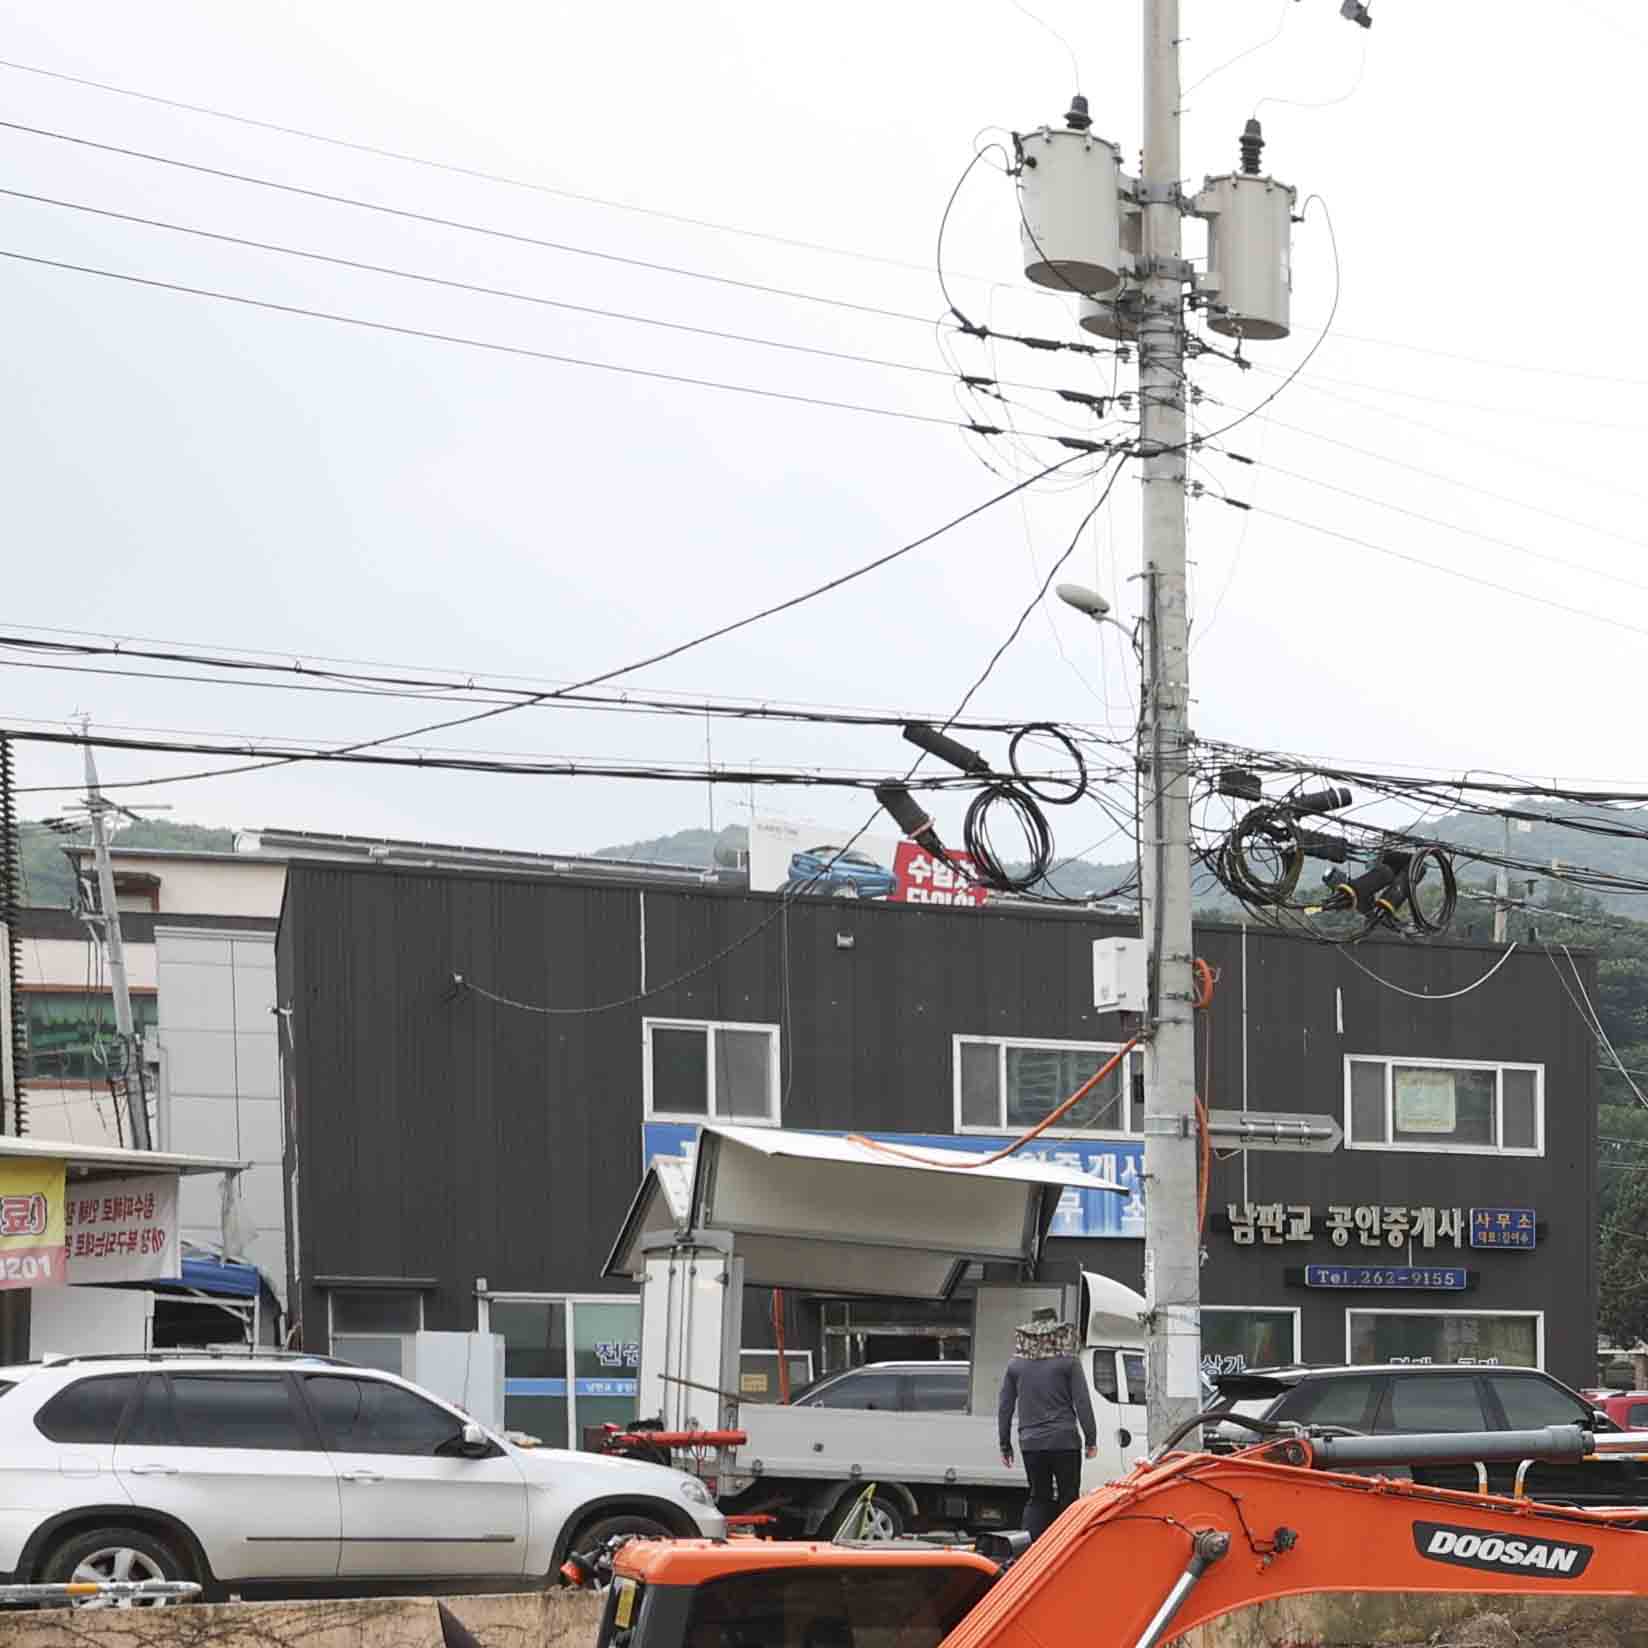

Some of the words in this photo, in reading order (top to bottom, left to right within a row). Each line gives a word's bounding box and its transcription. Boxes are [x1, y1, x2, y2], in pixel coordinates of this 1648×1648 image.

[1227, 1203, 1315, 1246] 남판교
[1325, 1205, 1464, 1249] 공인중개사
[1427, 1530, 1578, 1572] DOOSAN
